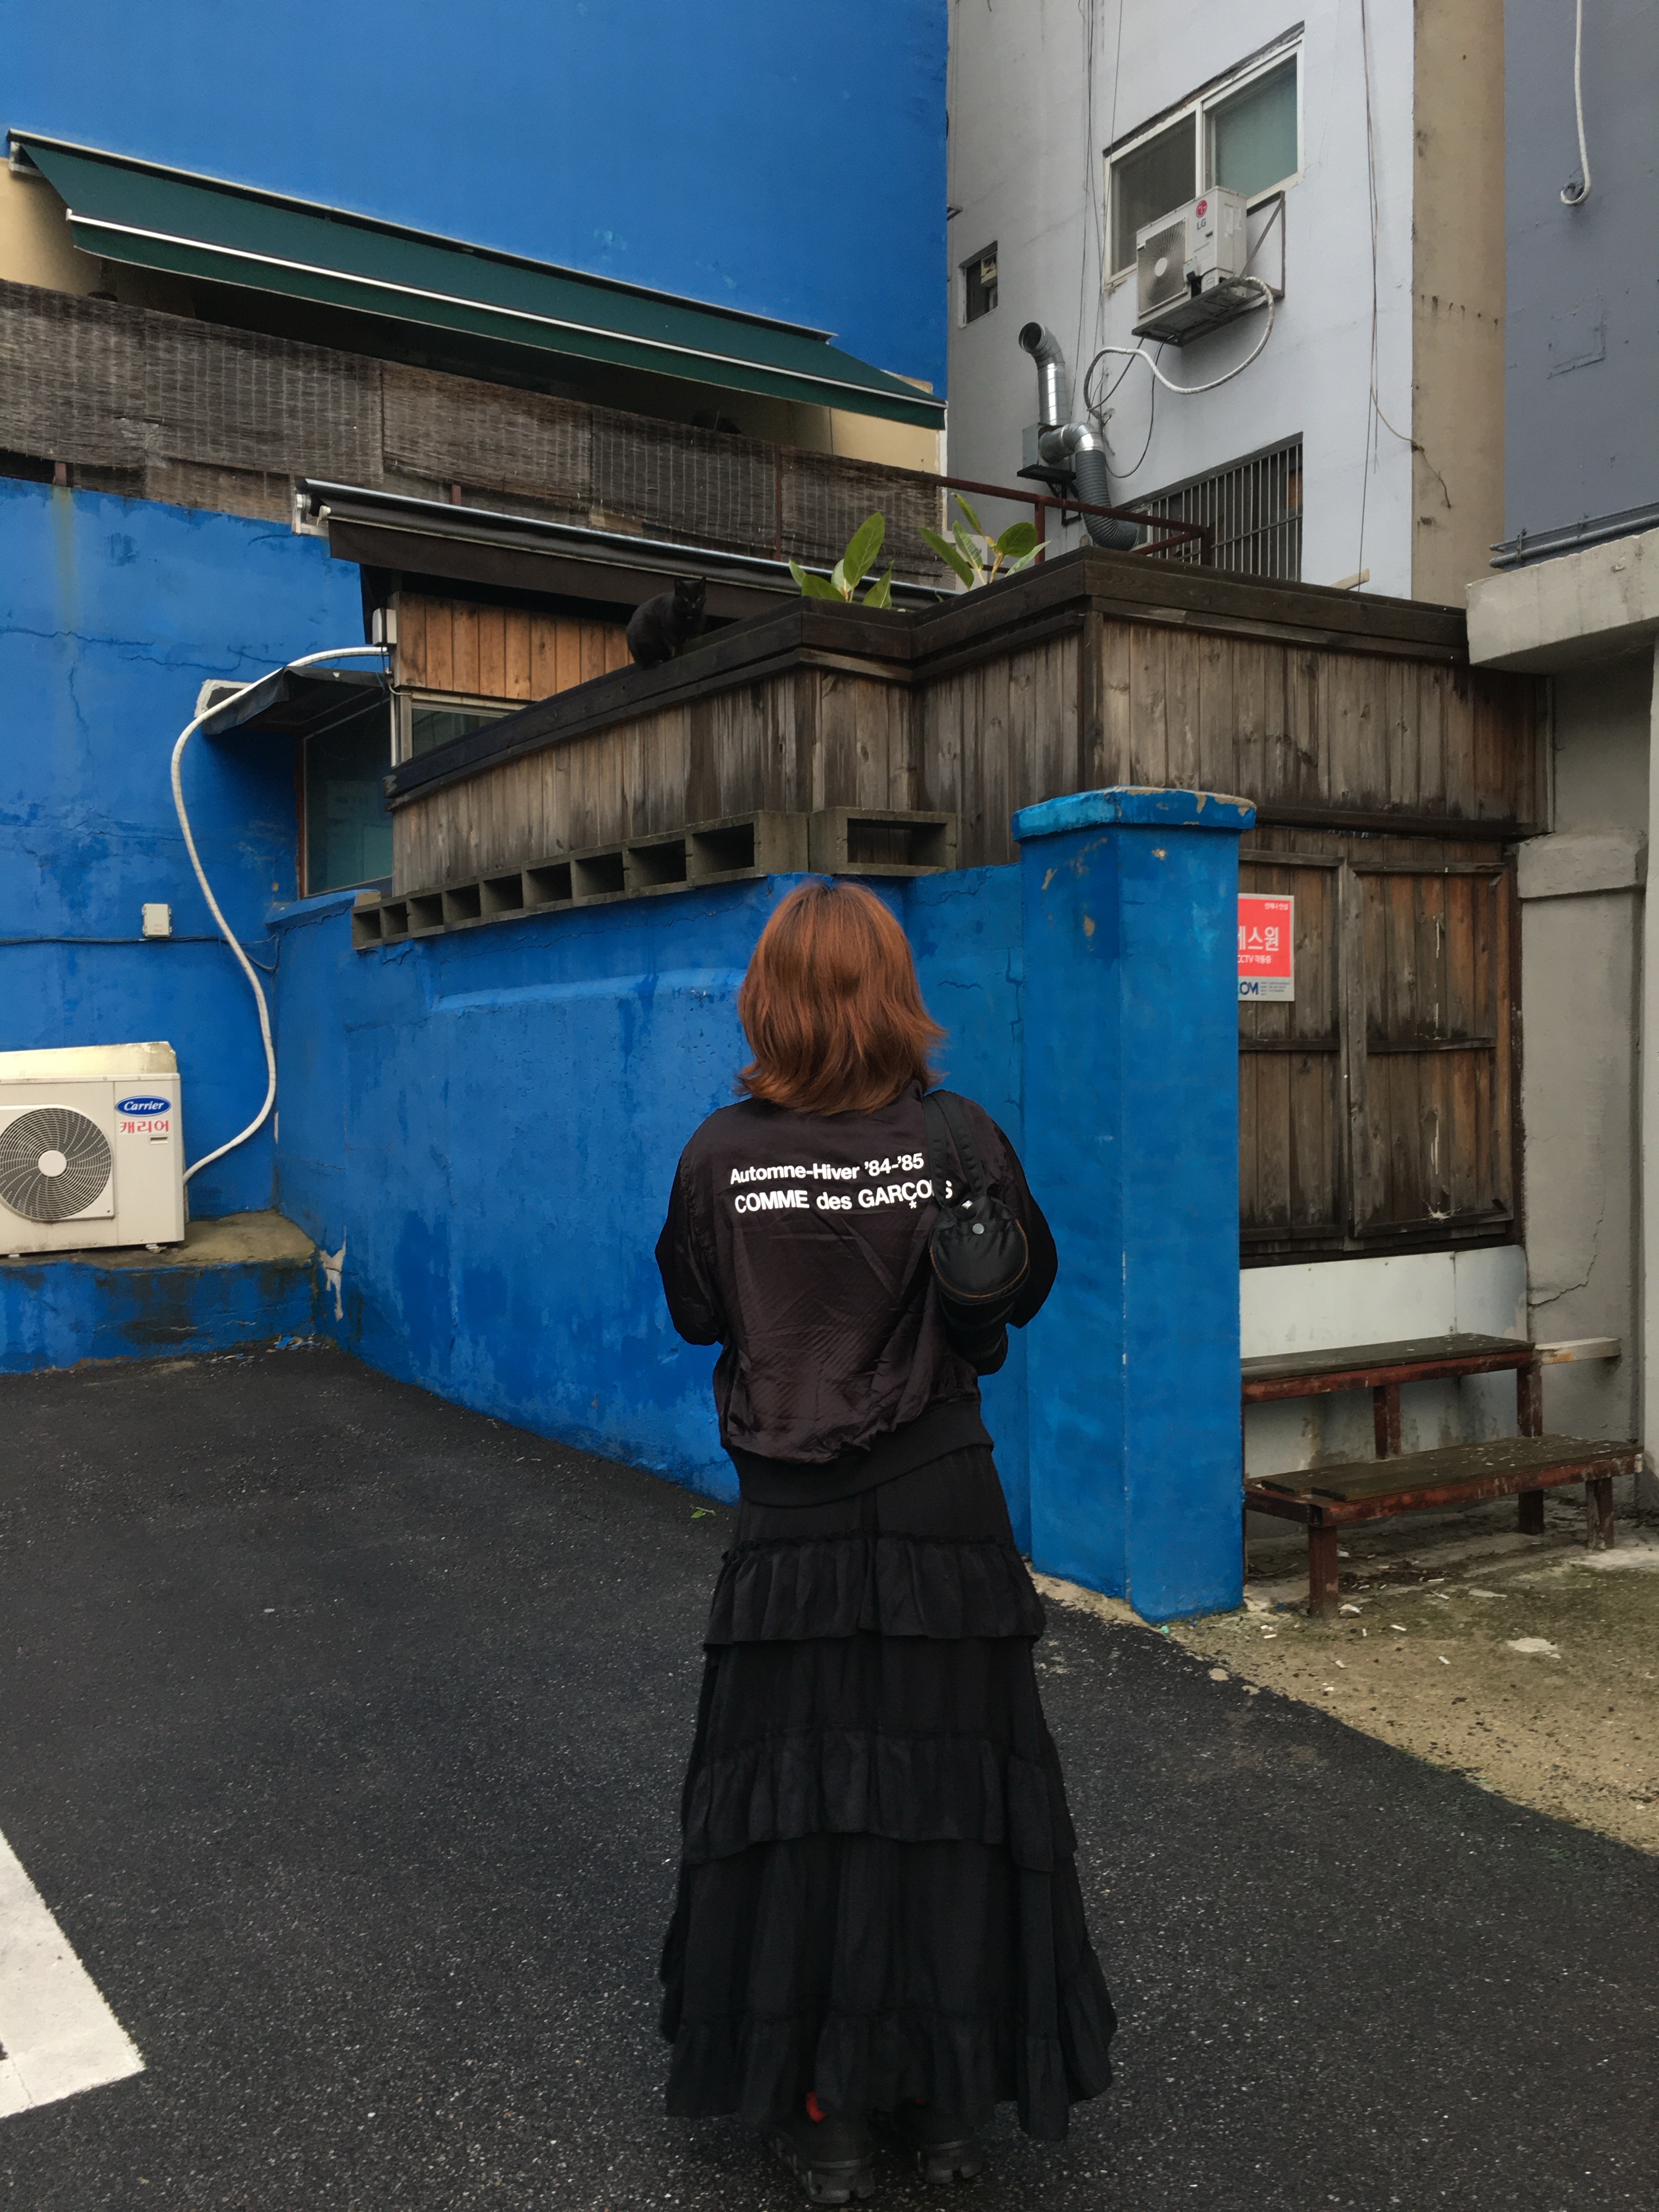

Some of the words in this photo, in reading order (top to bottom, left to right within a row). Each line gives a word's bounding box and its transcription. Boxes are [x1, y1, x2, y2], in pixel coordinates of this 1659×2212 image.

[1197, 218, 1206, 230] LG
[124, 1101, 164, 1111] Carrier
[120, 1120, 169, 1133] 캐리어
[730, 1163, 860, 1184] Automne-Hiver
[735, 1189, 810, 1213] COMME
[816, 1192, 852, 1210] des
